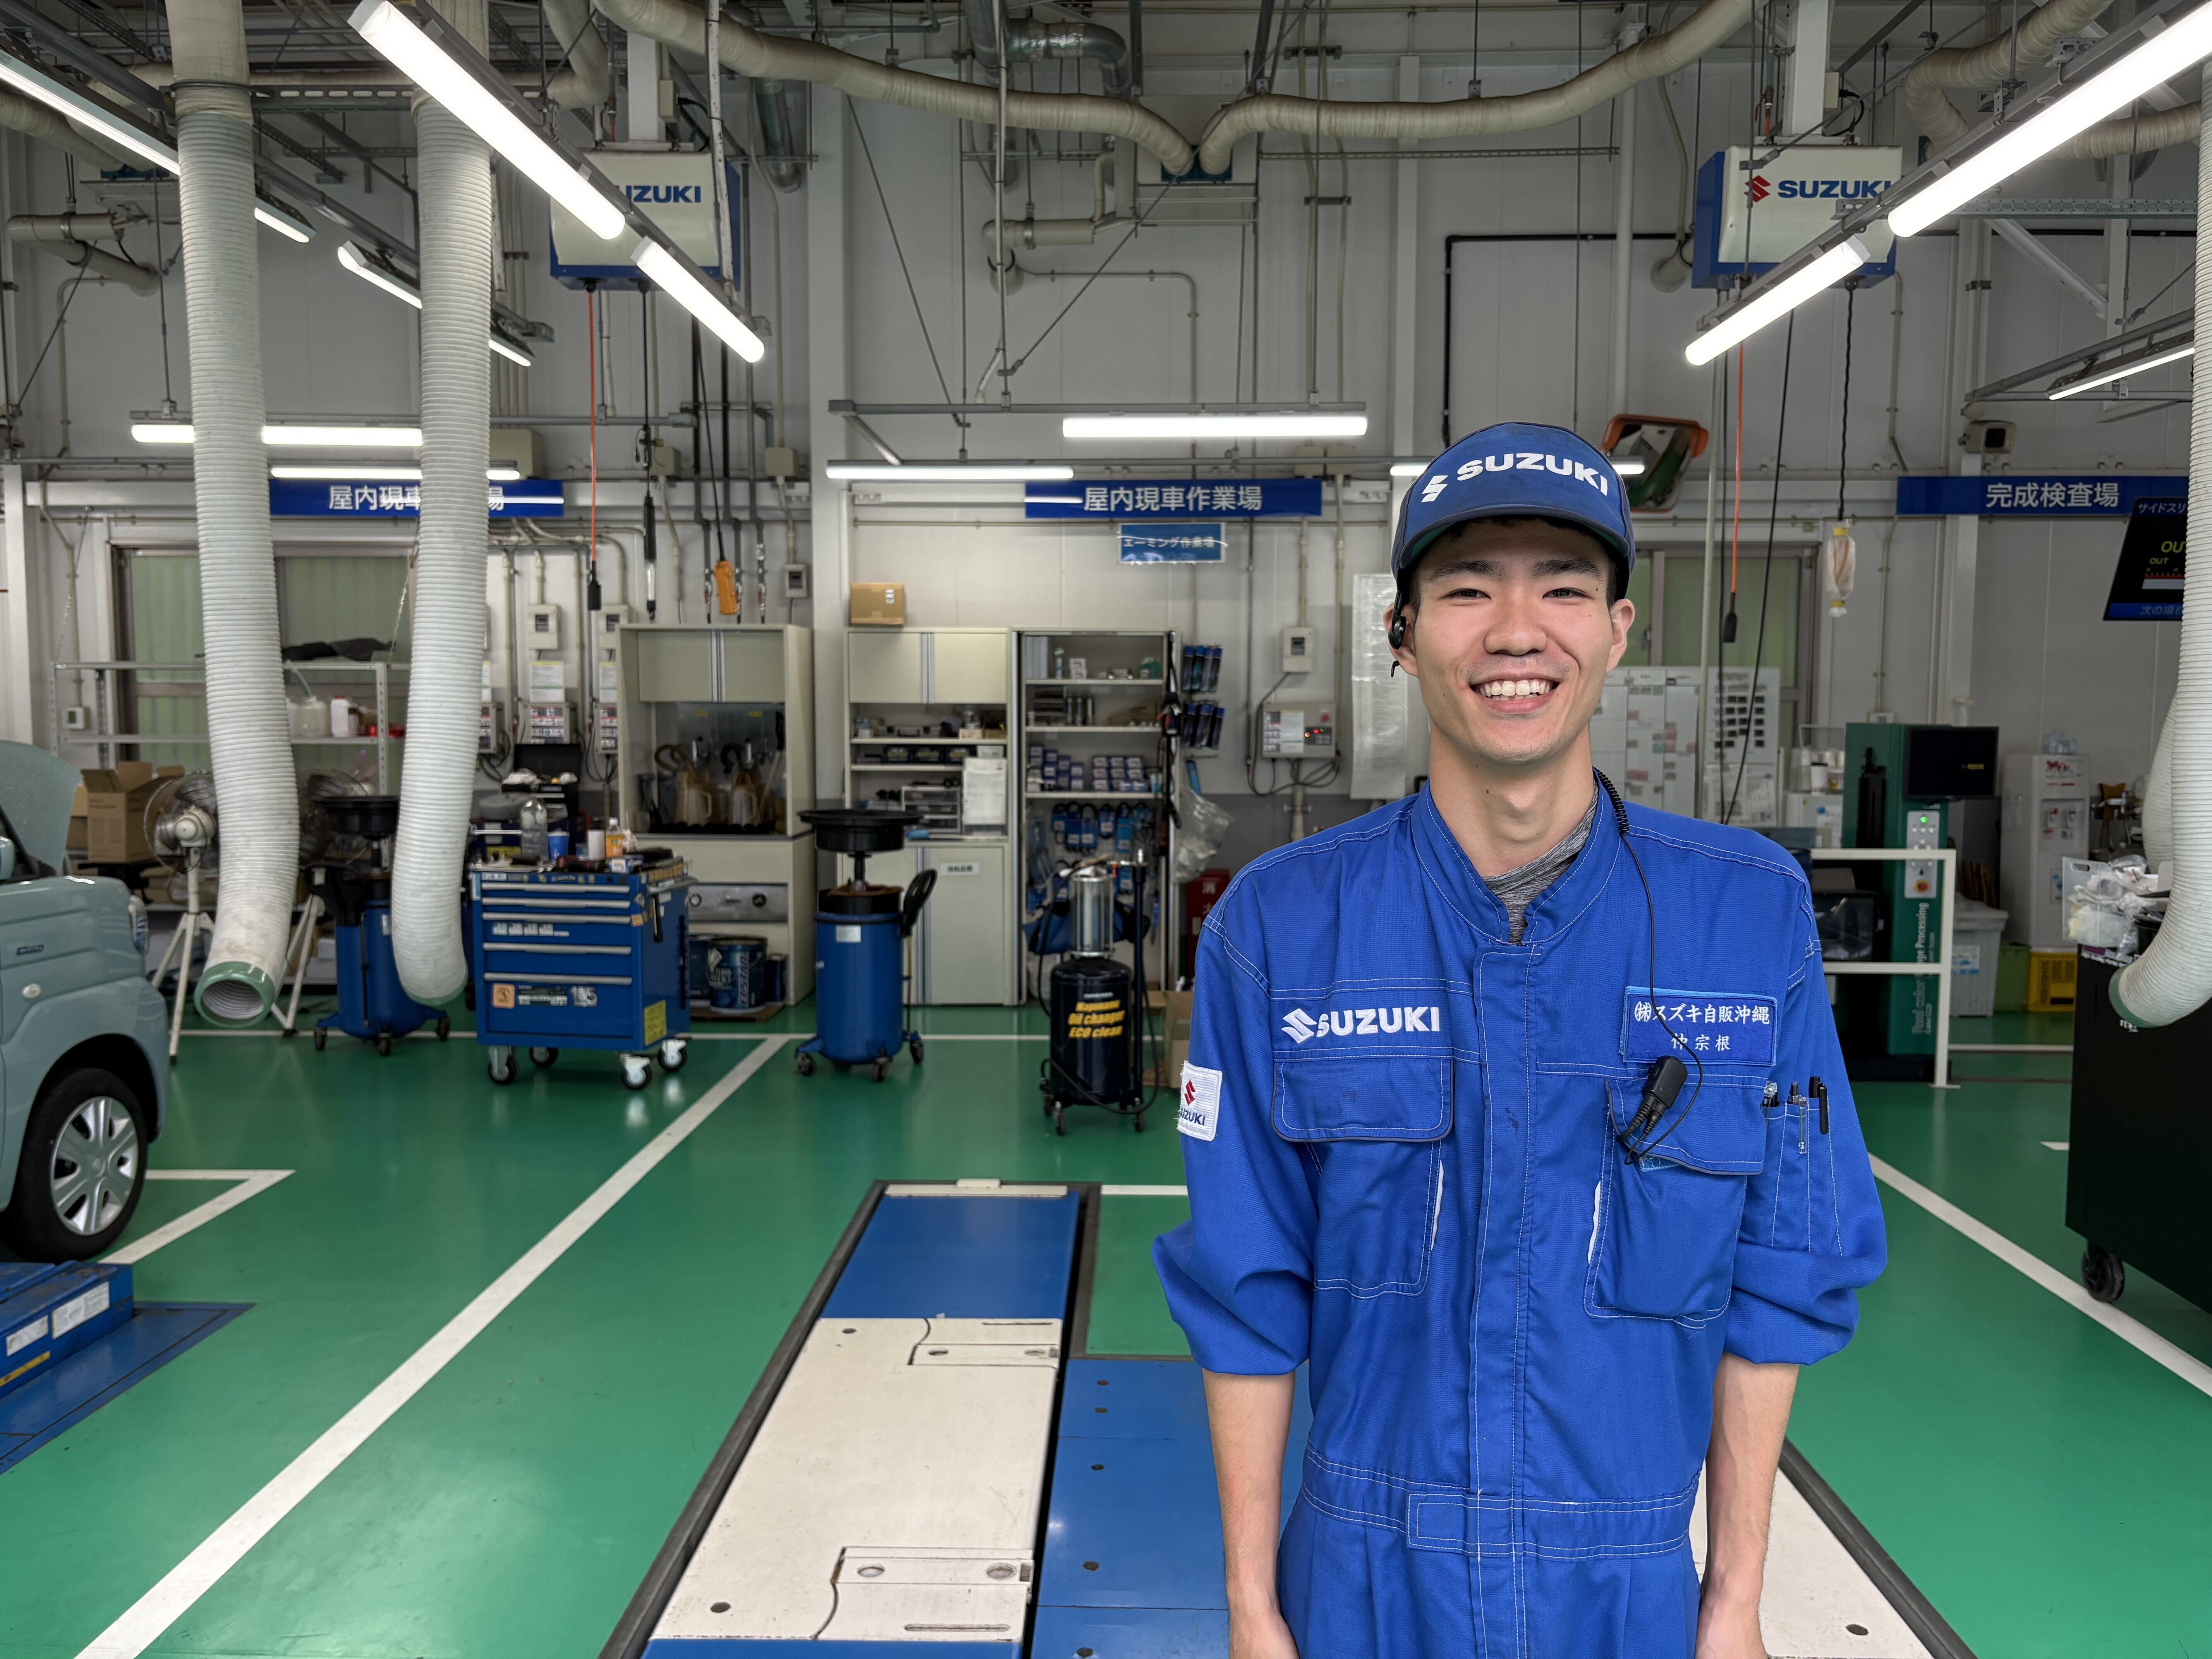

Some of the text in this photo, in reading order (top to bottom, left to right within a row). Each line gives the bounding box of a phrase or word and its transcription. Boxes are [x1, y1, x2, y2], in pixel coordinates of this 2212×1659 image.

[1457, 453, 1608, 496] SUZUKI
[1084, 486, 1262, 511] 屋内現車作業場
[1986, 483, 2119, 508] 完成検査場
[2138, 503, 2188, 514] サイドスリ
[1123, 536, 1214, 548] エーミング作業場
[1915, 903, 1929, 948] Processing
[1084, 1010, 1125, 1025] changer
[1316, 1007, 1440, 1038] SUZUKI
[1068, 1025, 1123, 1039] ECO clean
[1179, 1108, 1206, 1126] UZUKI
